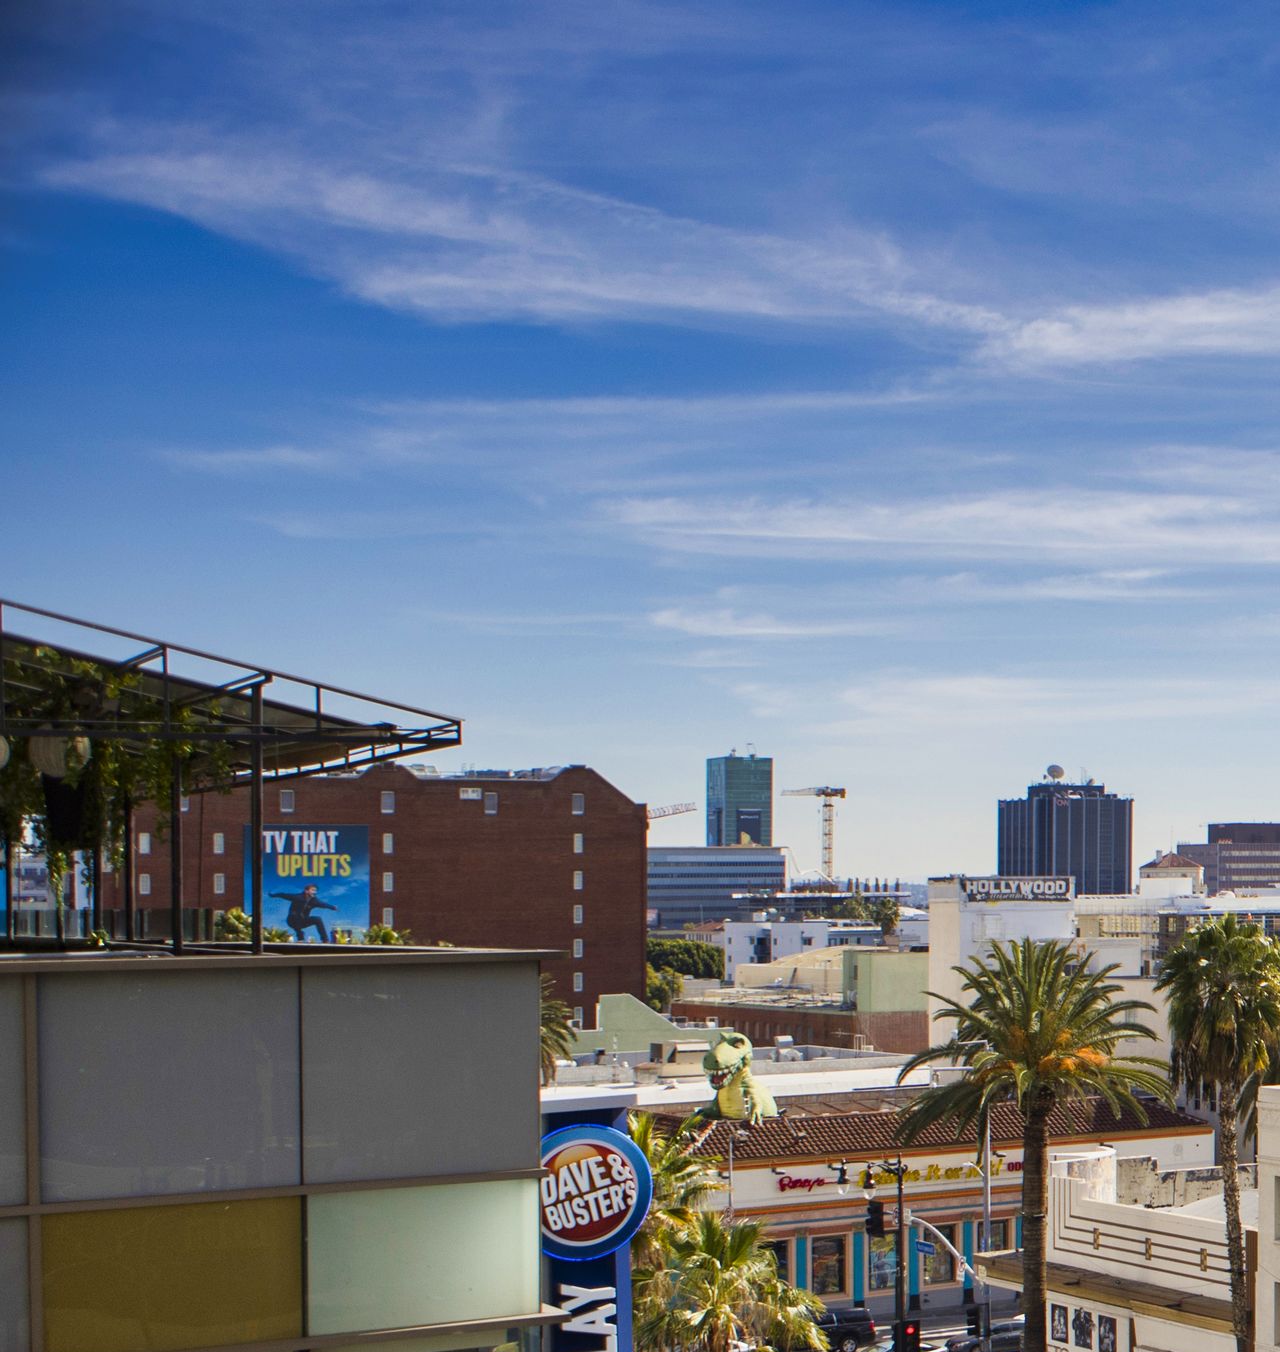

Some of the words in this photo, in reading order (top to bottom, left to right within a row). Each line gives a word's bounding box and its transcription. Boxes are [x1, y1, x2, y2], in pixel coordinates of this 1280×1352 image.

[262, 831, 287, 853] TV
[290, 831, 339, 853] THAT
[277, 854, 351, 877] UPLIFTS
[966, 880, 1067, 894] HOLLYWOOD
[541, 1156, 611, 1207] DAVE
[607, 1154, 634, 1182] &
[924, 1164, 941, 1181] It
[545, 1180, 637, 1231] BUSTER'S
